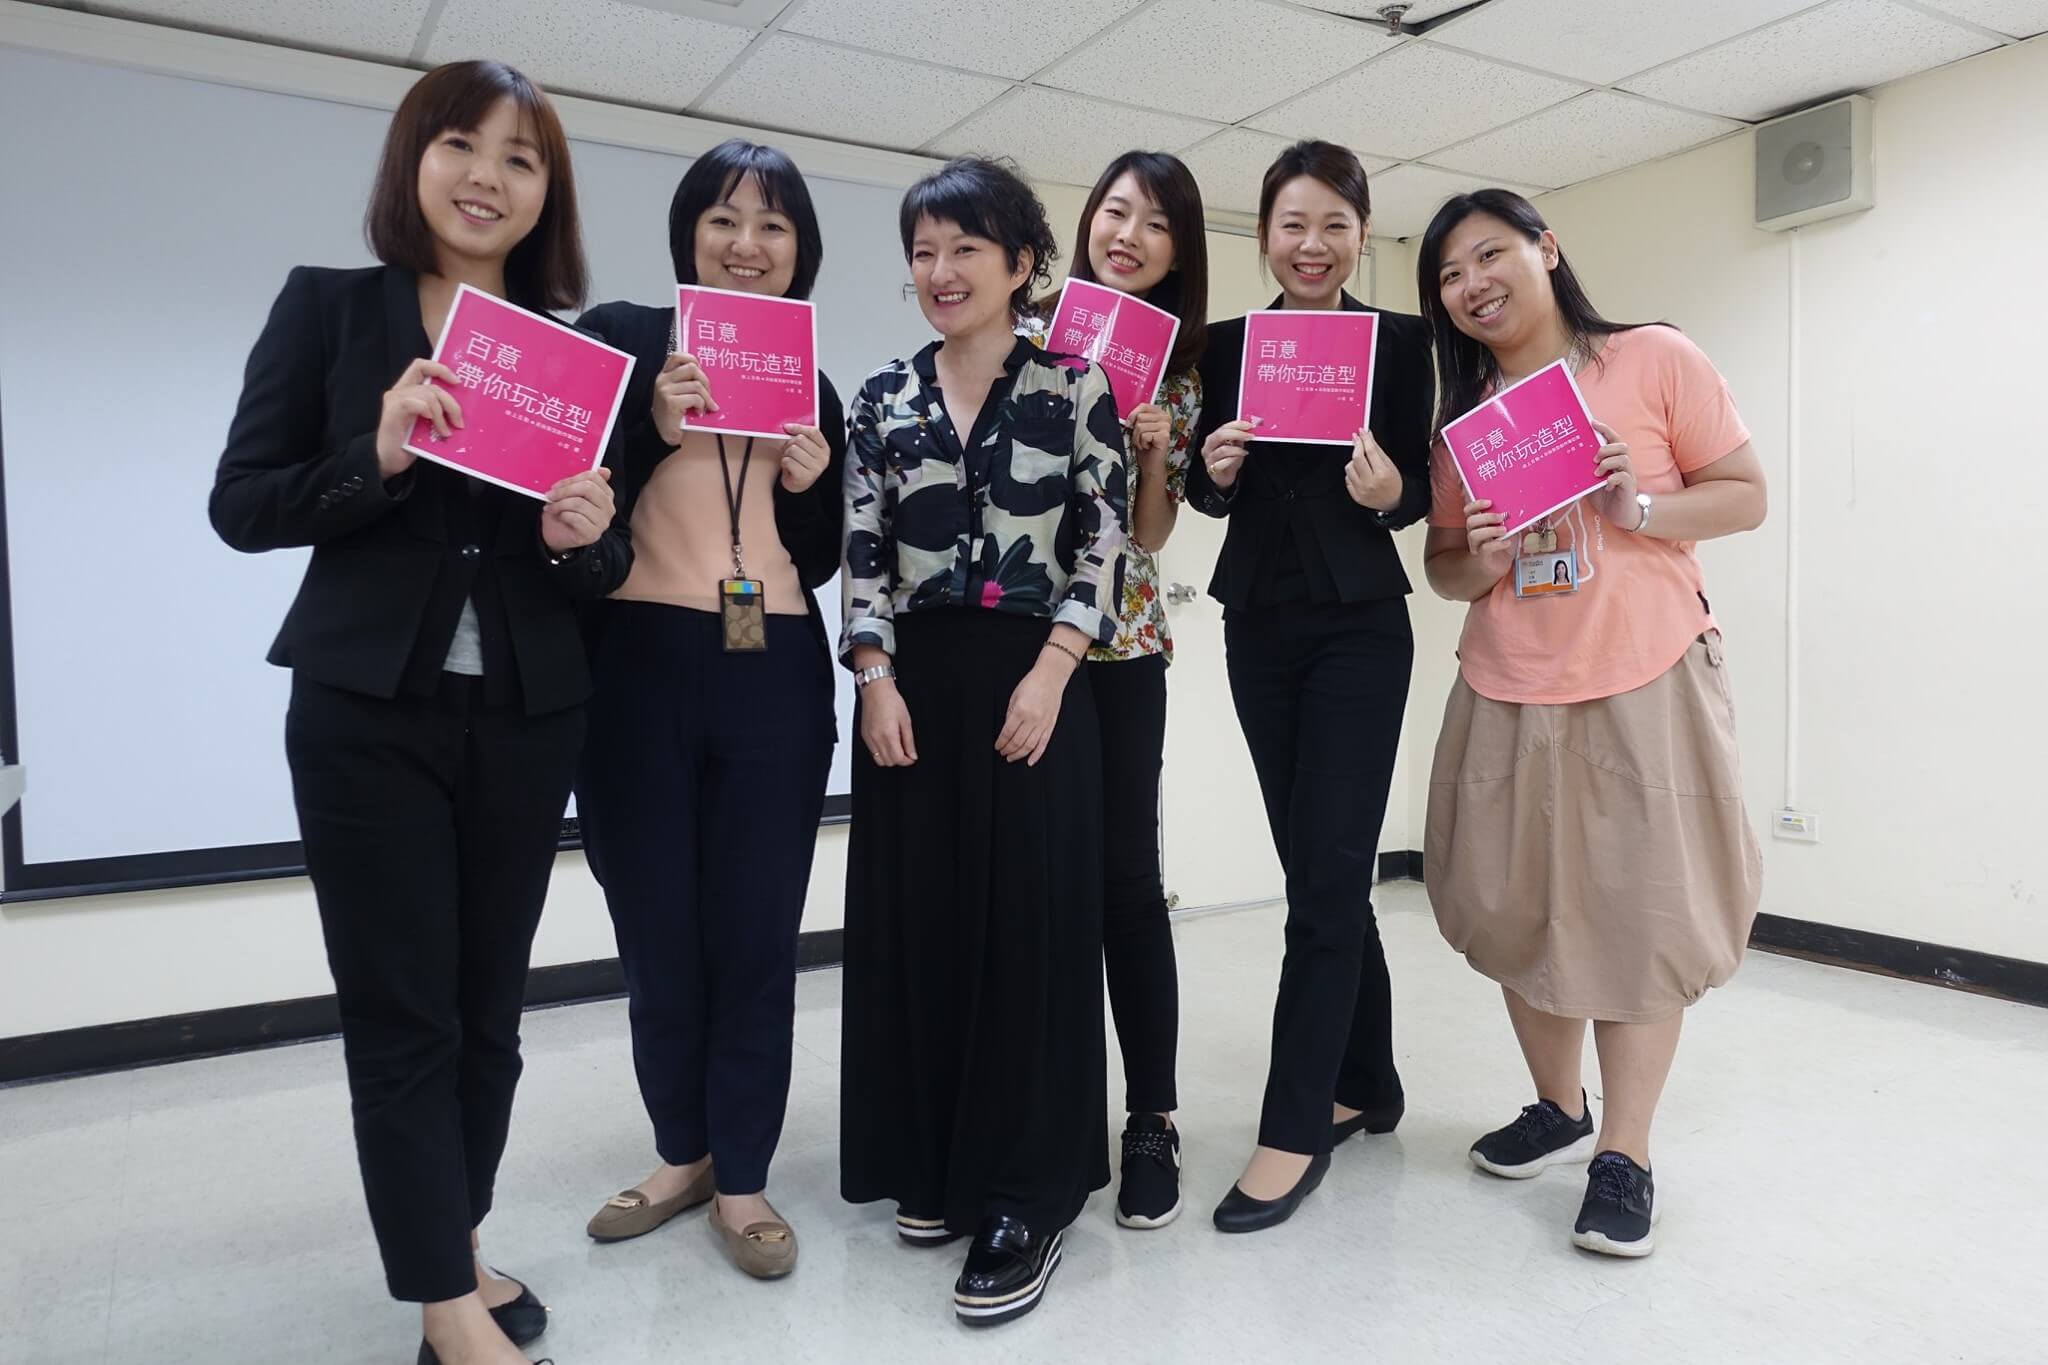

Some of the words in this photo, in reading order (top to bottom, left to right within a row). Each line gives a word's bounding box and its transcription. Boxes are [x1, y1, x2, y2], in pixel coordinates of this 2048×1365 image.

[696, 319, 738, 343] 百意
[1071, 306, 1108, 333] 百意
[466, 329, 522, 373] 百意
[697, 346, 803, 377] 帶你玩造型
[1260, 340, 1298, 359] 百意
[1257, 364, 1356, 385] 帶你玩造型
[455, 361, 593, 434] 帶你玩造型
[1466, 427, 1508, 461] 百意
[1477, 415, 1578, 481] 帶你玩造型
